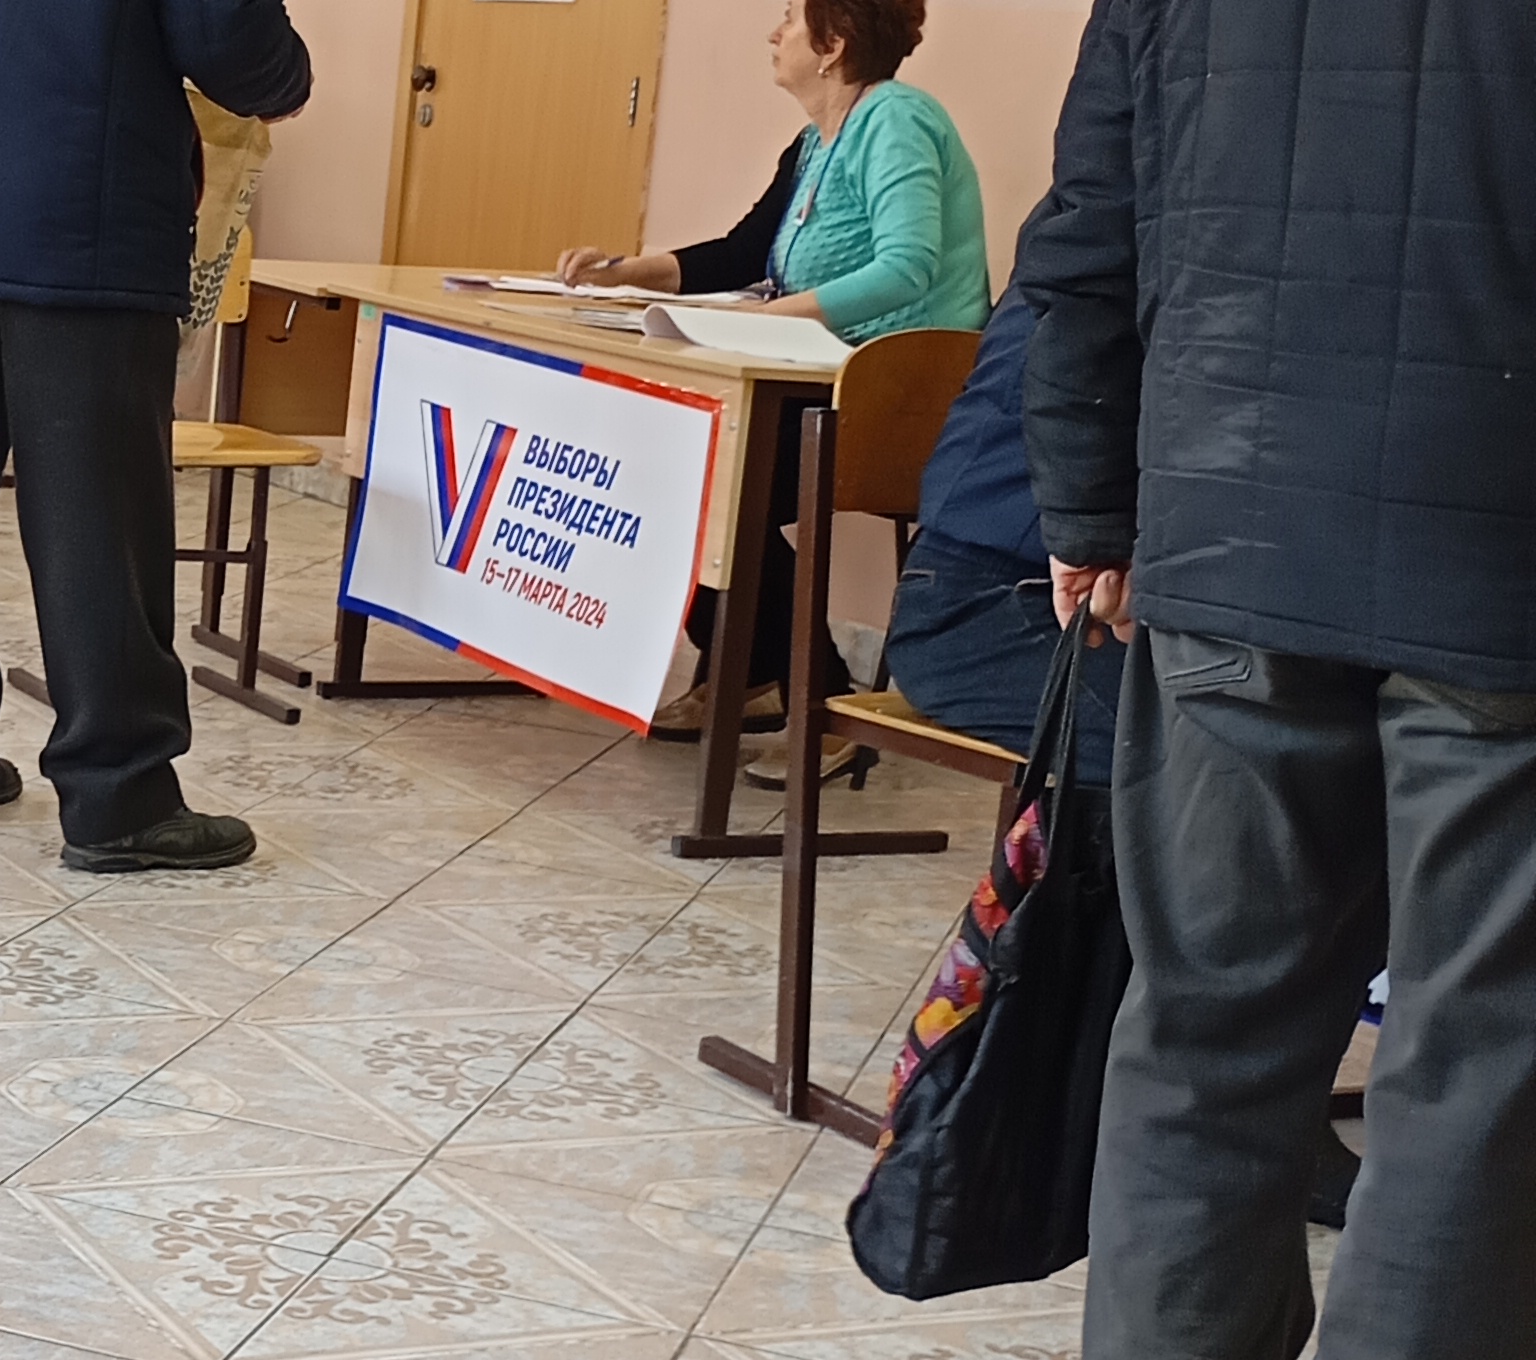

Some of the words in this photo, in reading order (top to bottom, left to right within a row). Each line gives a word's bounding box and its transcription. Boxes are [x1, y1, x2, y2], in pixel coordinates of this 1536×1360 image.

[523, 434, 620, 491] ВЫБОРЫ
[507, 476, 642, 549] ПРЕЗИДЕНТА
[492, 518, 576, 573] РОССИИ
[517, 571, 568, 614] МАРТА
[566, 592, 608, 629] 2024
